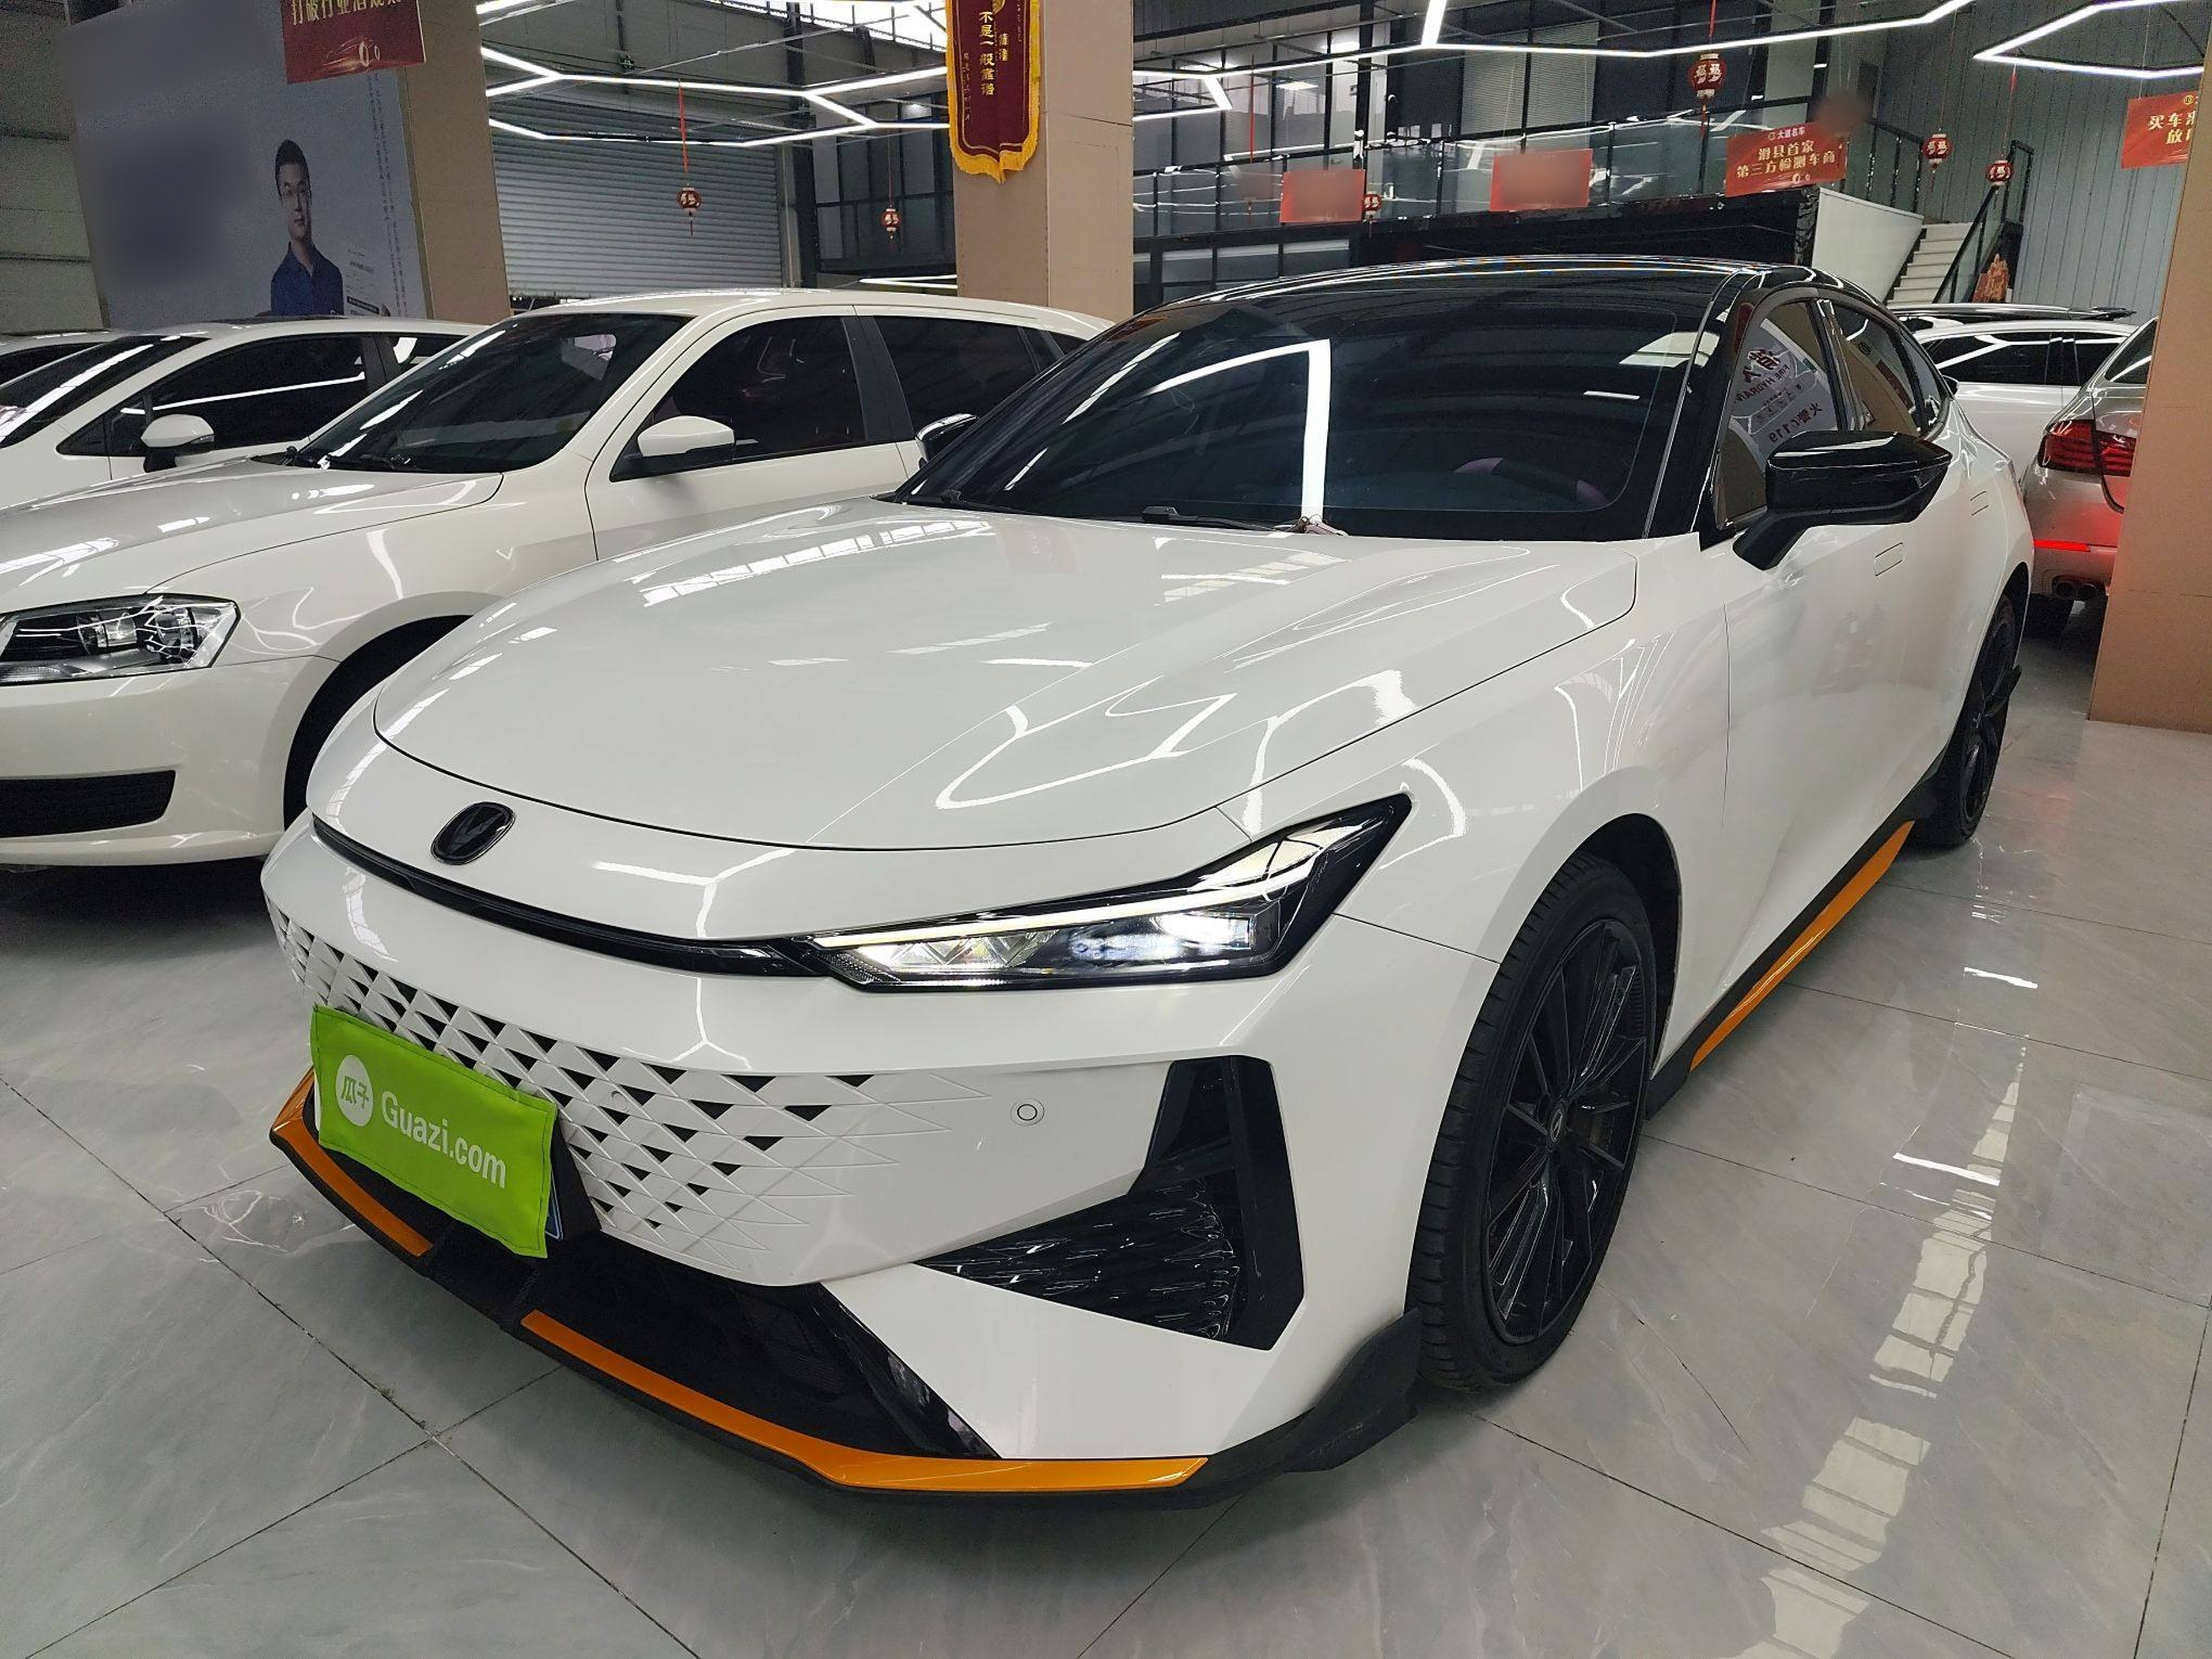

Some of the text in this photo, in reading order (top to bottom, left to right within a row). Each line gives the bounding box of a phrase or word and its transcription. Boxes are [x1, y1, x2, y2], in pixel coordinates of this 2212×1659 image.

[1736, 150, 1835, 179] 第三方检测车商
[1758, 140, 1814, 161] 滑县首家
[340, 1075, 369, 1109] 瓜子
[381, 1090, 506, 1190] Guazi.com
